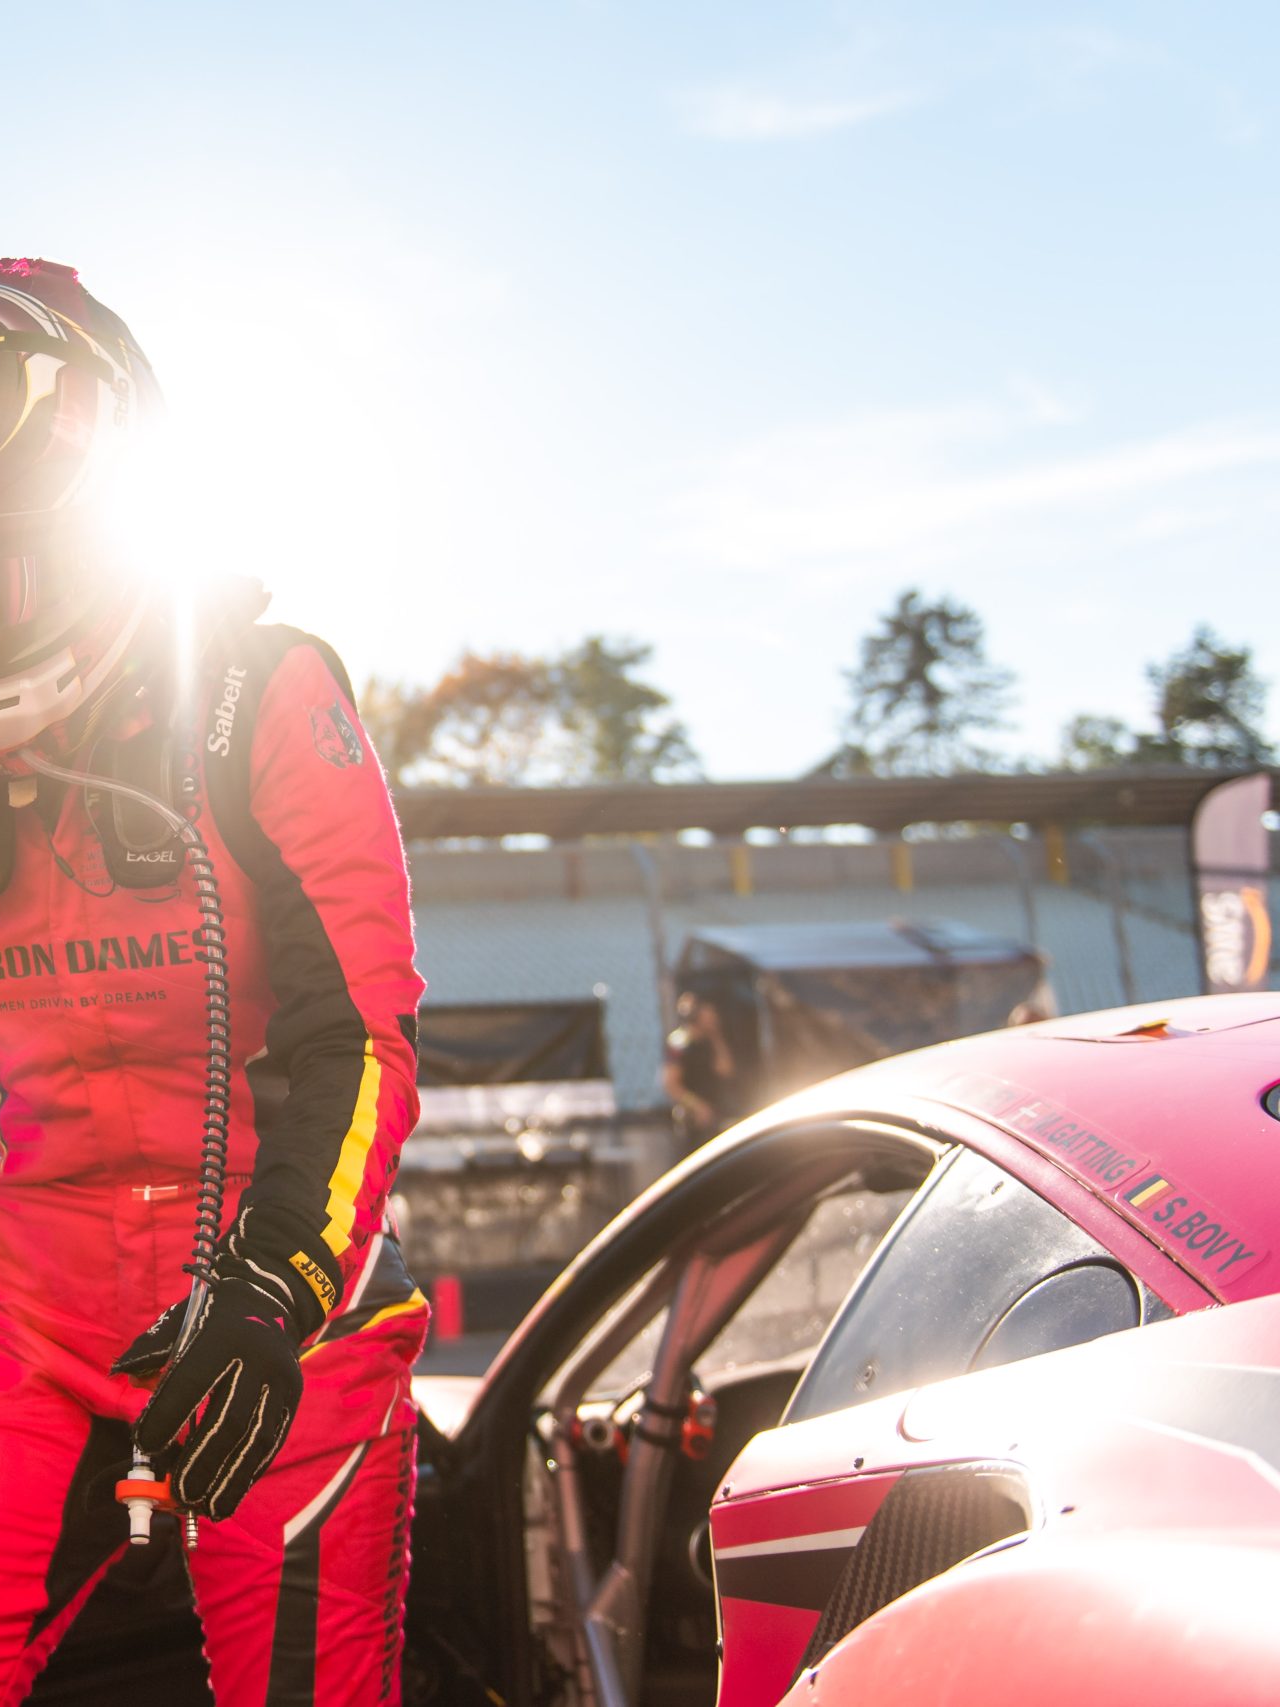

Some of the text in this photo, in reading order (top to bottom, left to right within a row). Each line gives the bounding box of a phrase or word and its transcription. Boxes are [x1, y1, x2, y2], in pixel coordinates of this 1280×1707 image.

[207, 664, 248, 758] Sabelt
[65, 929, 216, 975] DAMES
[29, 998, 74, 1011] DRIVN
[80, 994, 98, 1008] BY
[104, 989, 167, 1005] DREAMS
[1152, 1196, 1257, 1274] S.BOVY
[300, 1259, 336, 1306] abelt
